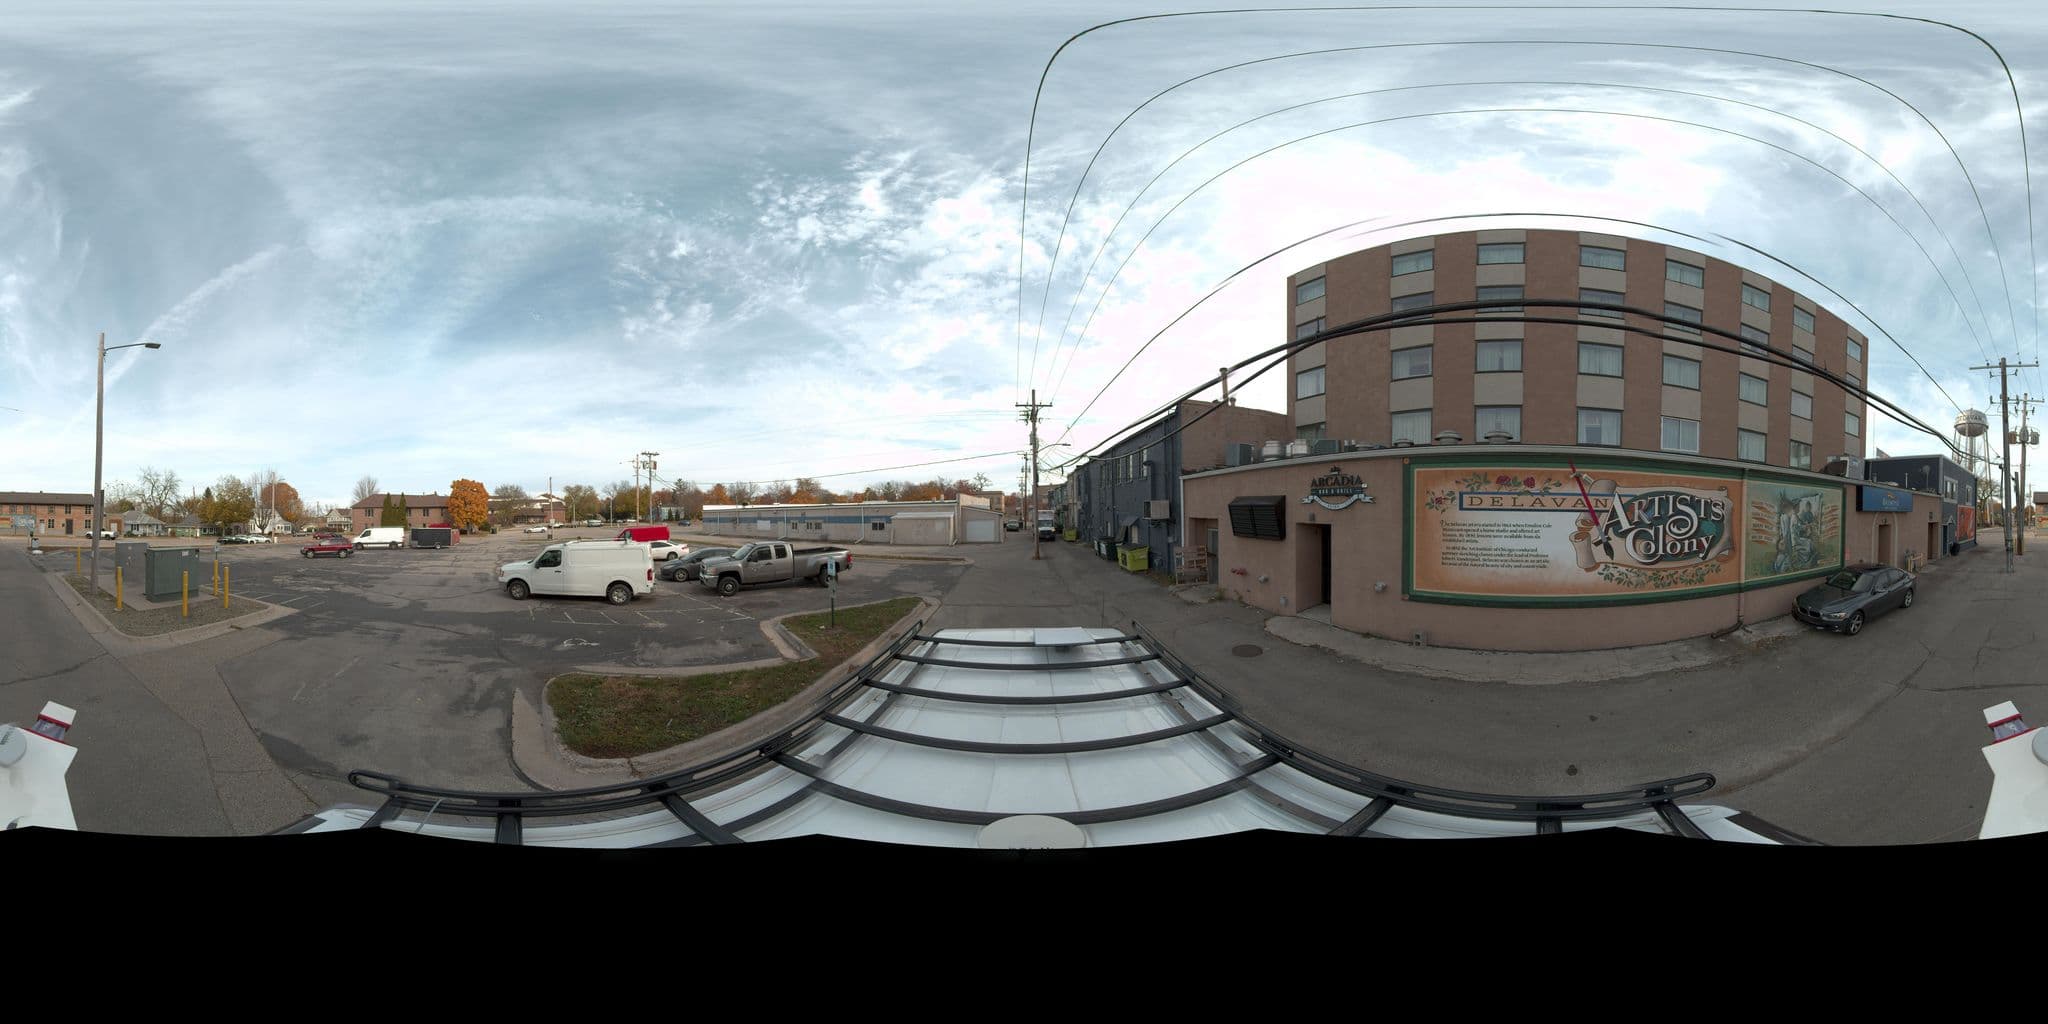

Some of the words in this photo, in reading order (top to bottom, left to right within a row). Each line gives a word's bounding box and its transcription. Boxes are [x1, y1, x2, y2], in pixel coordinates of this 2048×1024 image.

[1311, 474, 1362, 488] ARCADIA
[1468, 496, 1608, 509] DELAVAN
[1625, 524, 1714, 564] Colony
